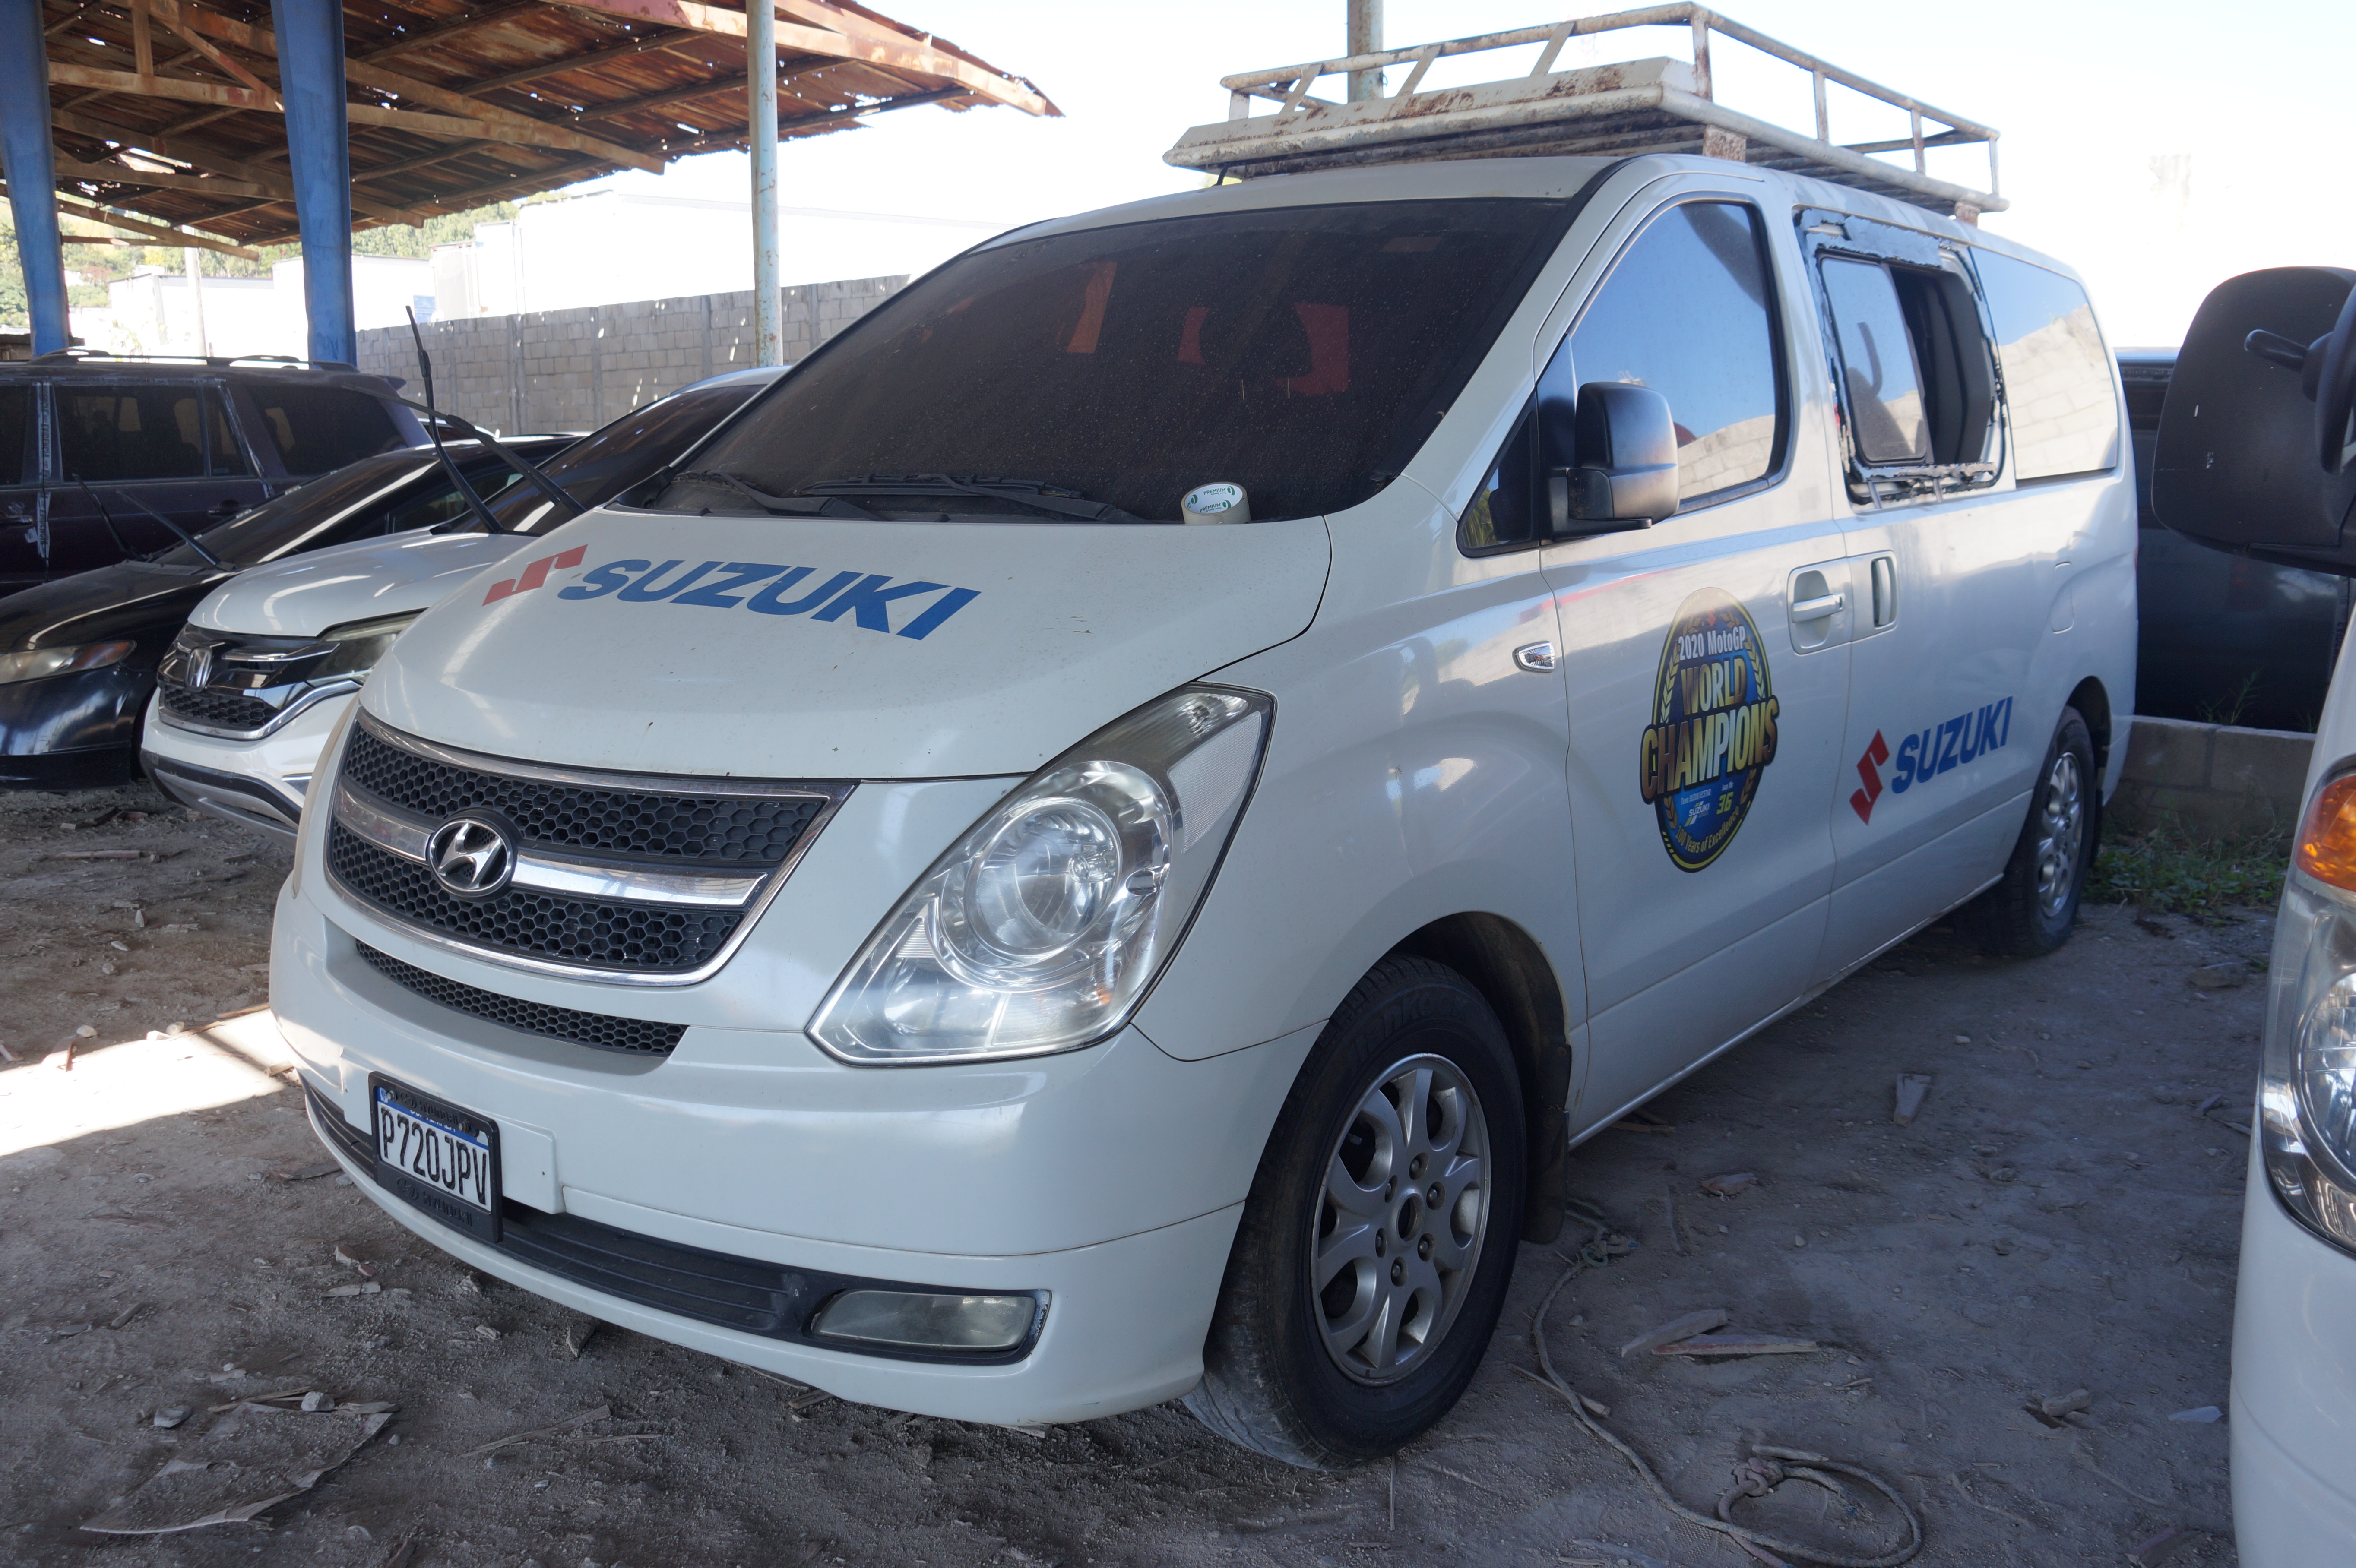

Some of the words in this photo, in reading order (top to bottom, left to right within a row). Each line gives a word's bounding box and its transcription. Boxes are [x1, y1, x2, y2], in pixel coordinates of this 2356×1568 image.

[1200, 503, 1221, 513] PREMIUM
[557, 559, 982, 641] SUZUKI
[1678, 636, 1705, 661] 2020
[1707, 626, 1746, 655] MotoGP
[1680, 658, 1747, 716] WORLD
[1641, 698, 1779, 800] CHAMPIONS
[1891, 696, 2013, 794] SUZUKI
[1688, 803, 1710, 816] SUZUKI
[1716, 791, 1734, 815] 36
[1675, 826, 1687, 846] 100
[1685, 835, 1700, 853] Years
[1700, 836, 1708, 852] of
[1708, 806, 1739, 849] Excellence
[381, 1106, 487, 1205] P720JPV
